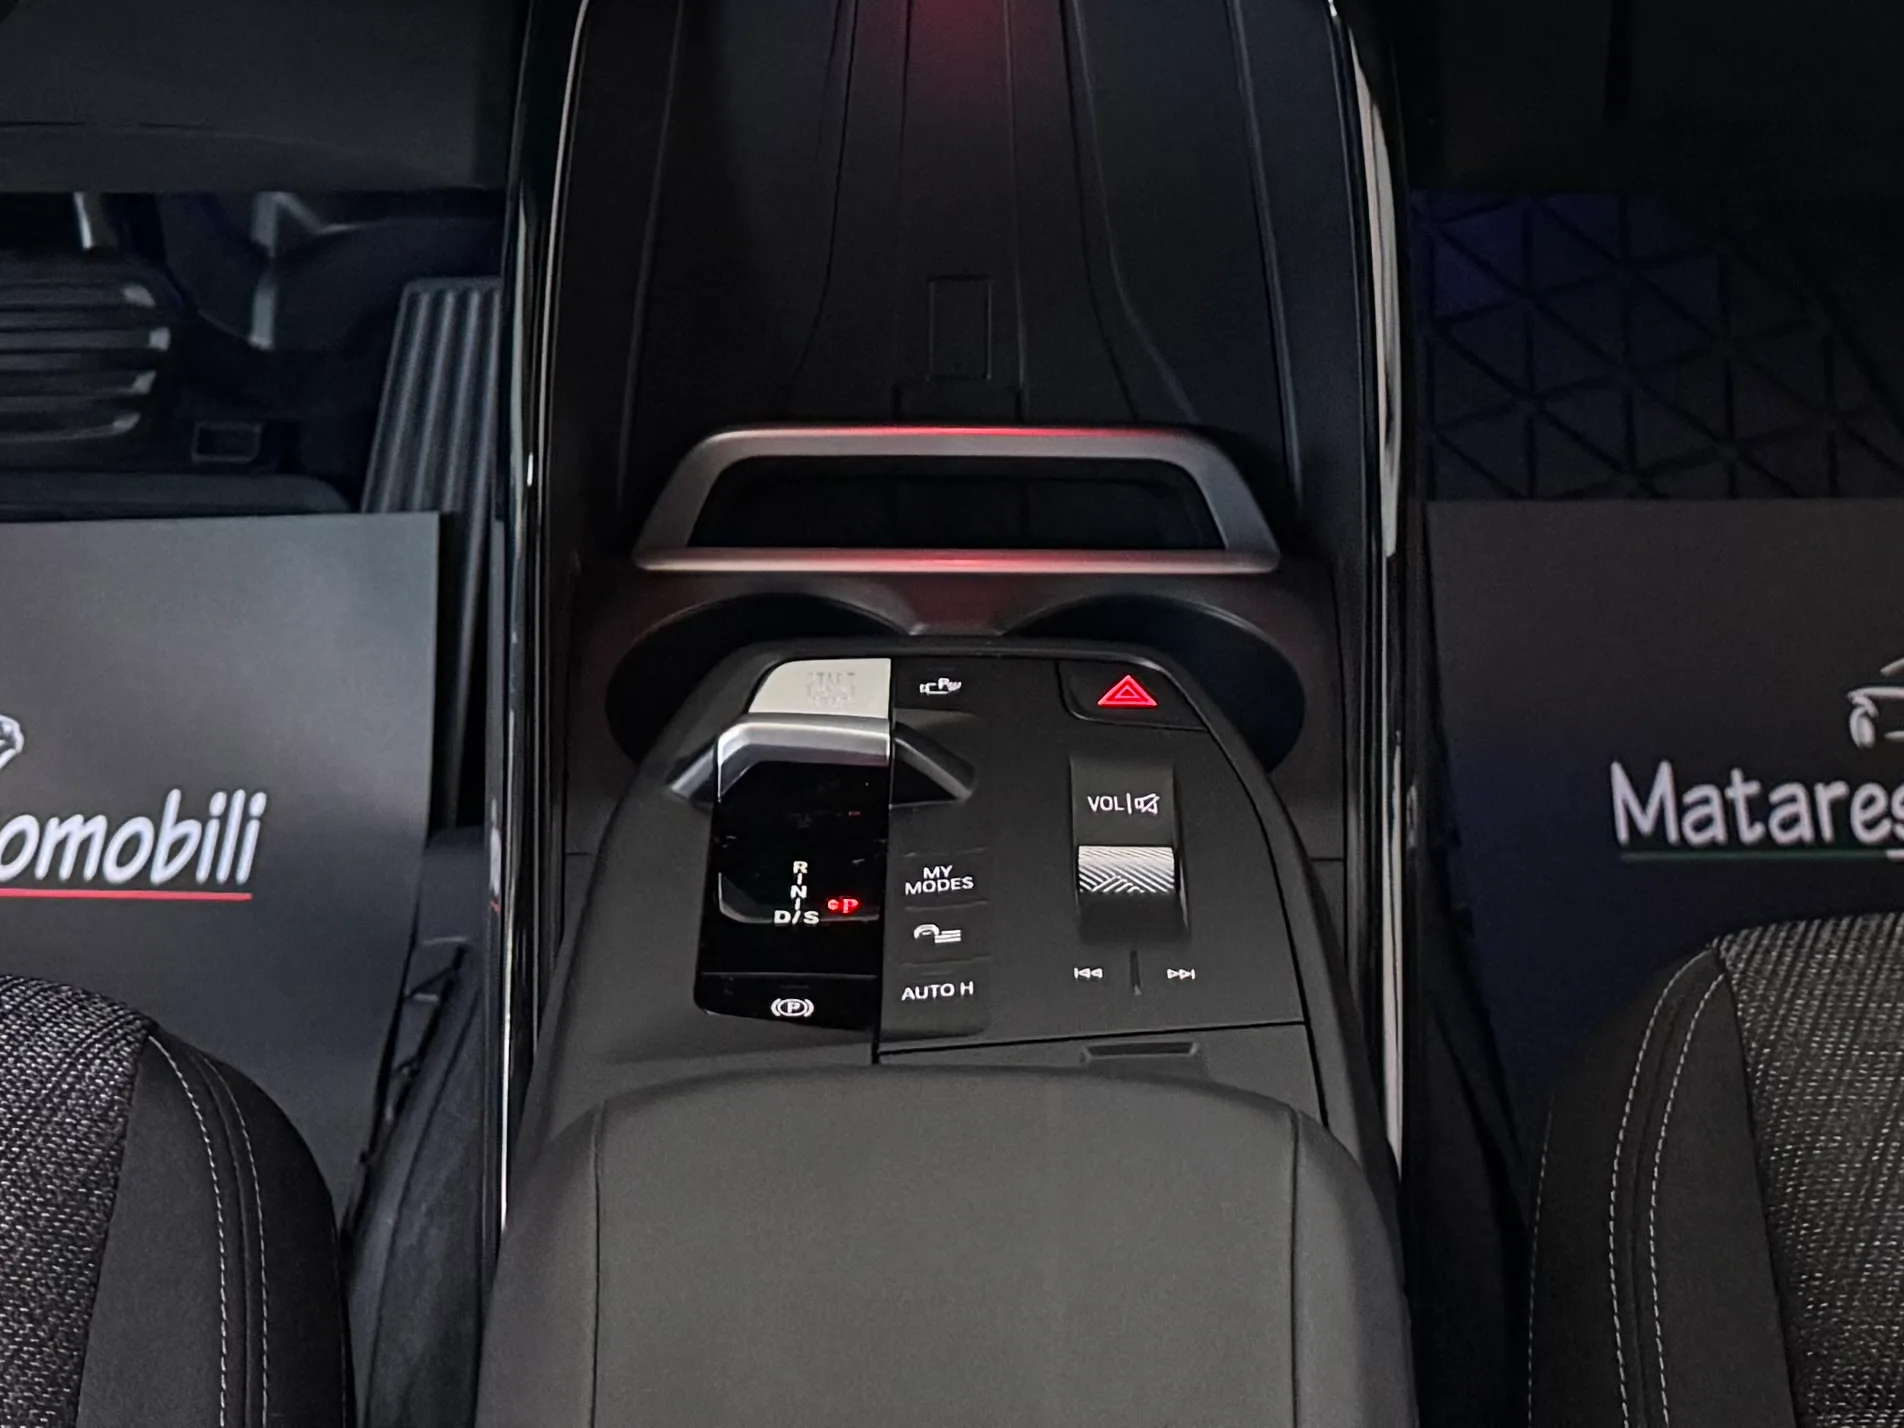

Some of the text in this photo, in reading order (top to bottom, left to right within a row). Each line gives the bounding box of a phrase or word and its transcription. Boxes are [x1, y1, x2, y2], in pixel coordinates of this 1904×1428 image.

[1087, 795, 1125, 812] VOL
[793, 860, 808, 874] R
[923, 865, 953, 880] MY
[790, 885, 808, 899] N
[905, 875, 974, 895] MODES
[773, 910, 820, 925] D/S
[901, 980, 974, 1001] AUTO H
